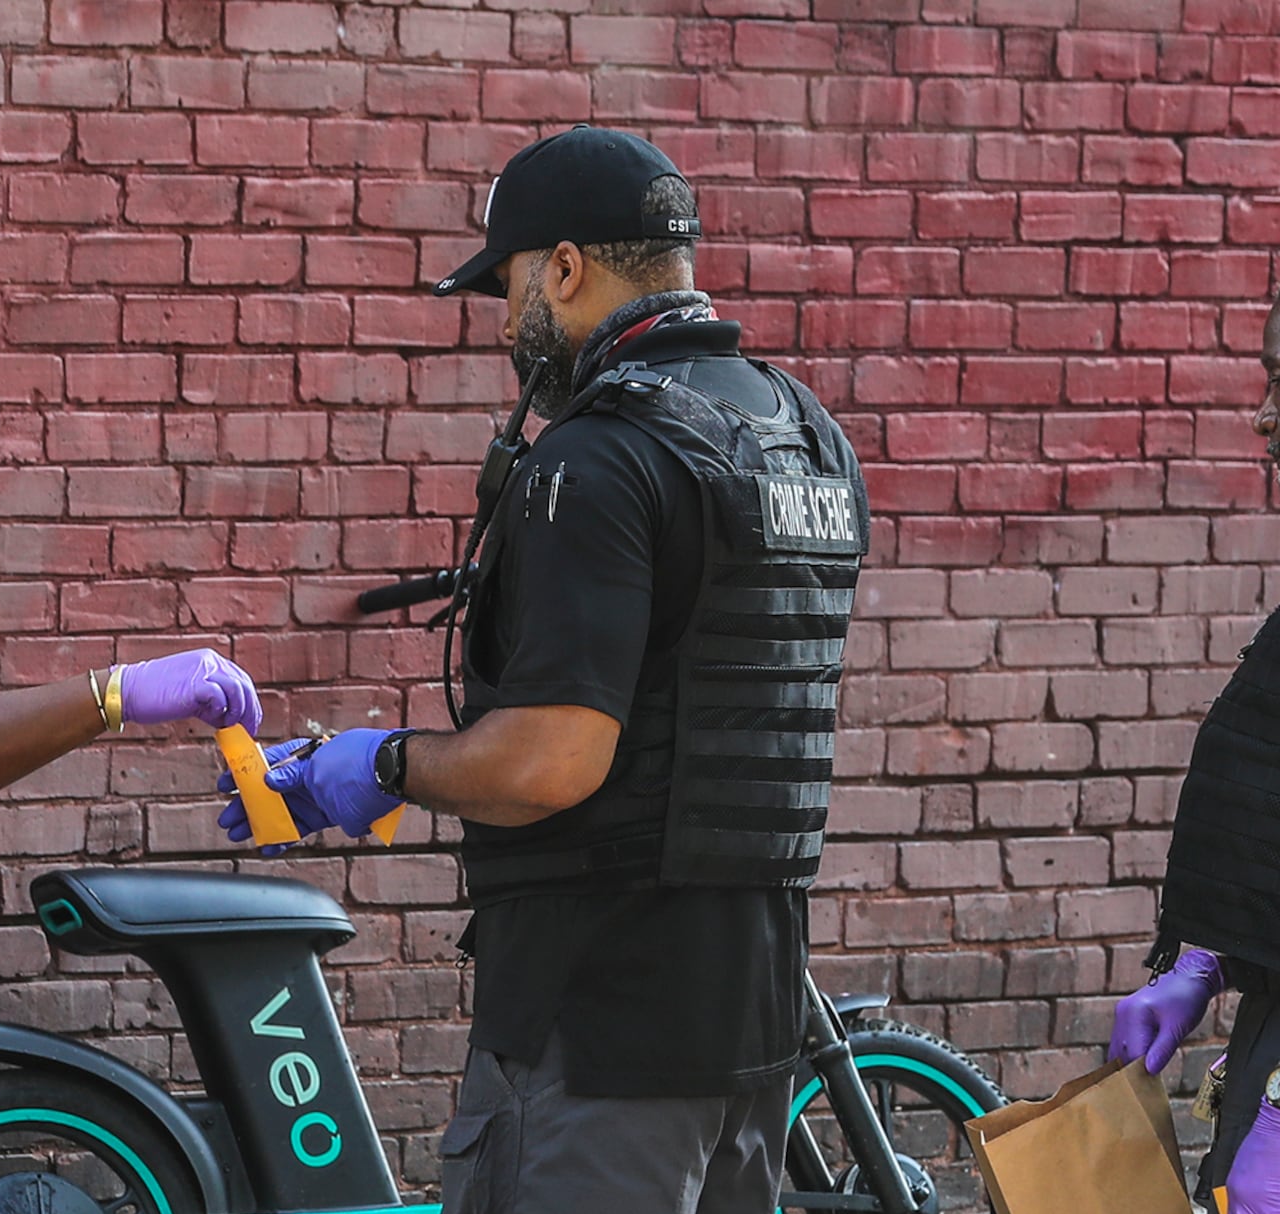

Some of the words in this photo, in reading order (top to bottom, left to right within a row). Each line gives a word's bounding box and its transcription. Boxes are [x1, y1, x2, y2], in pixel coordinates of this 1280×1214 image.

[668, 218, 690, 233] CSI
[768, 481, 811, 538] CRIME
[808, 484, 854, 542] SCENE
[249, 987, 343, 1168] veo
